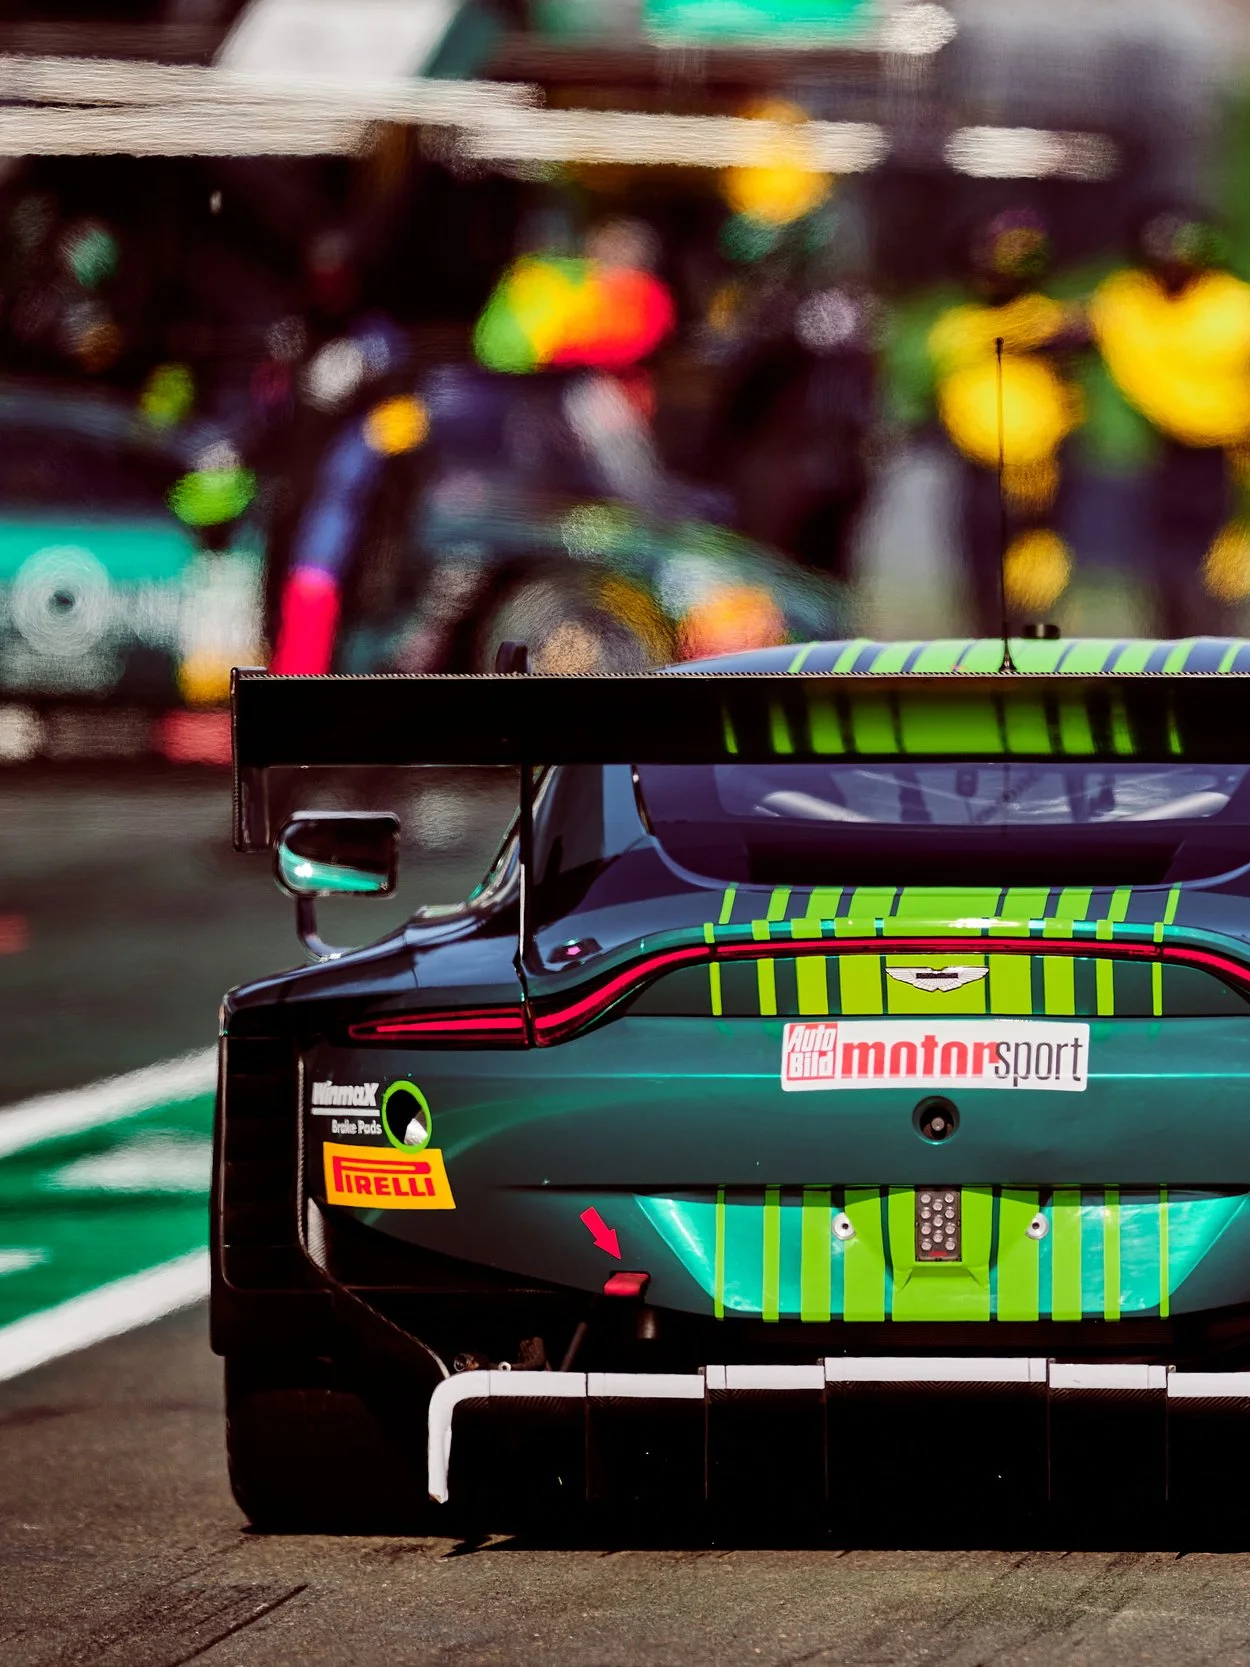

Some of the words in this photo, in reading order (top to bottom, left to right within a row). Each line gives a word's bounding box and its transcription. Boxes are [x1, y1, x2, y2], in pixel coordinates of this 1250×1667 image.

[788, 1024, 837, 1053] Auto
[788, 1050, 835, 1078] Bild
[331, 1118, 357, 1135] Brake
[357, 1119, 382, 1135] Pads
[332, 1156, 436, 1196] PIRELLI
